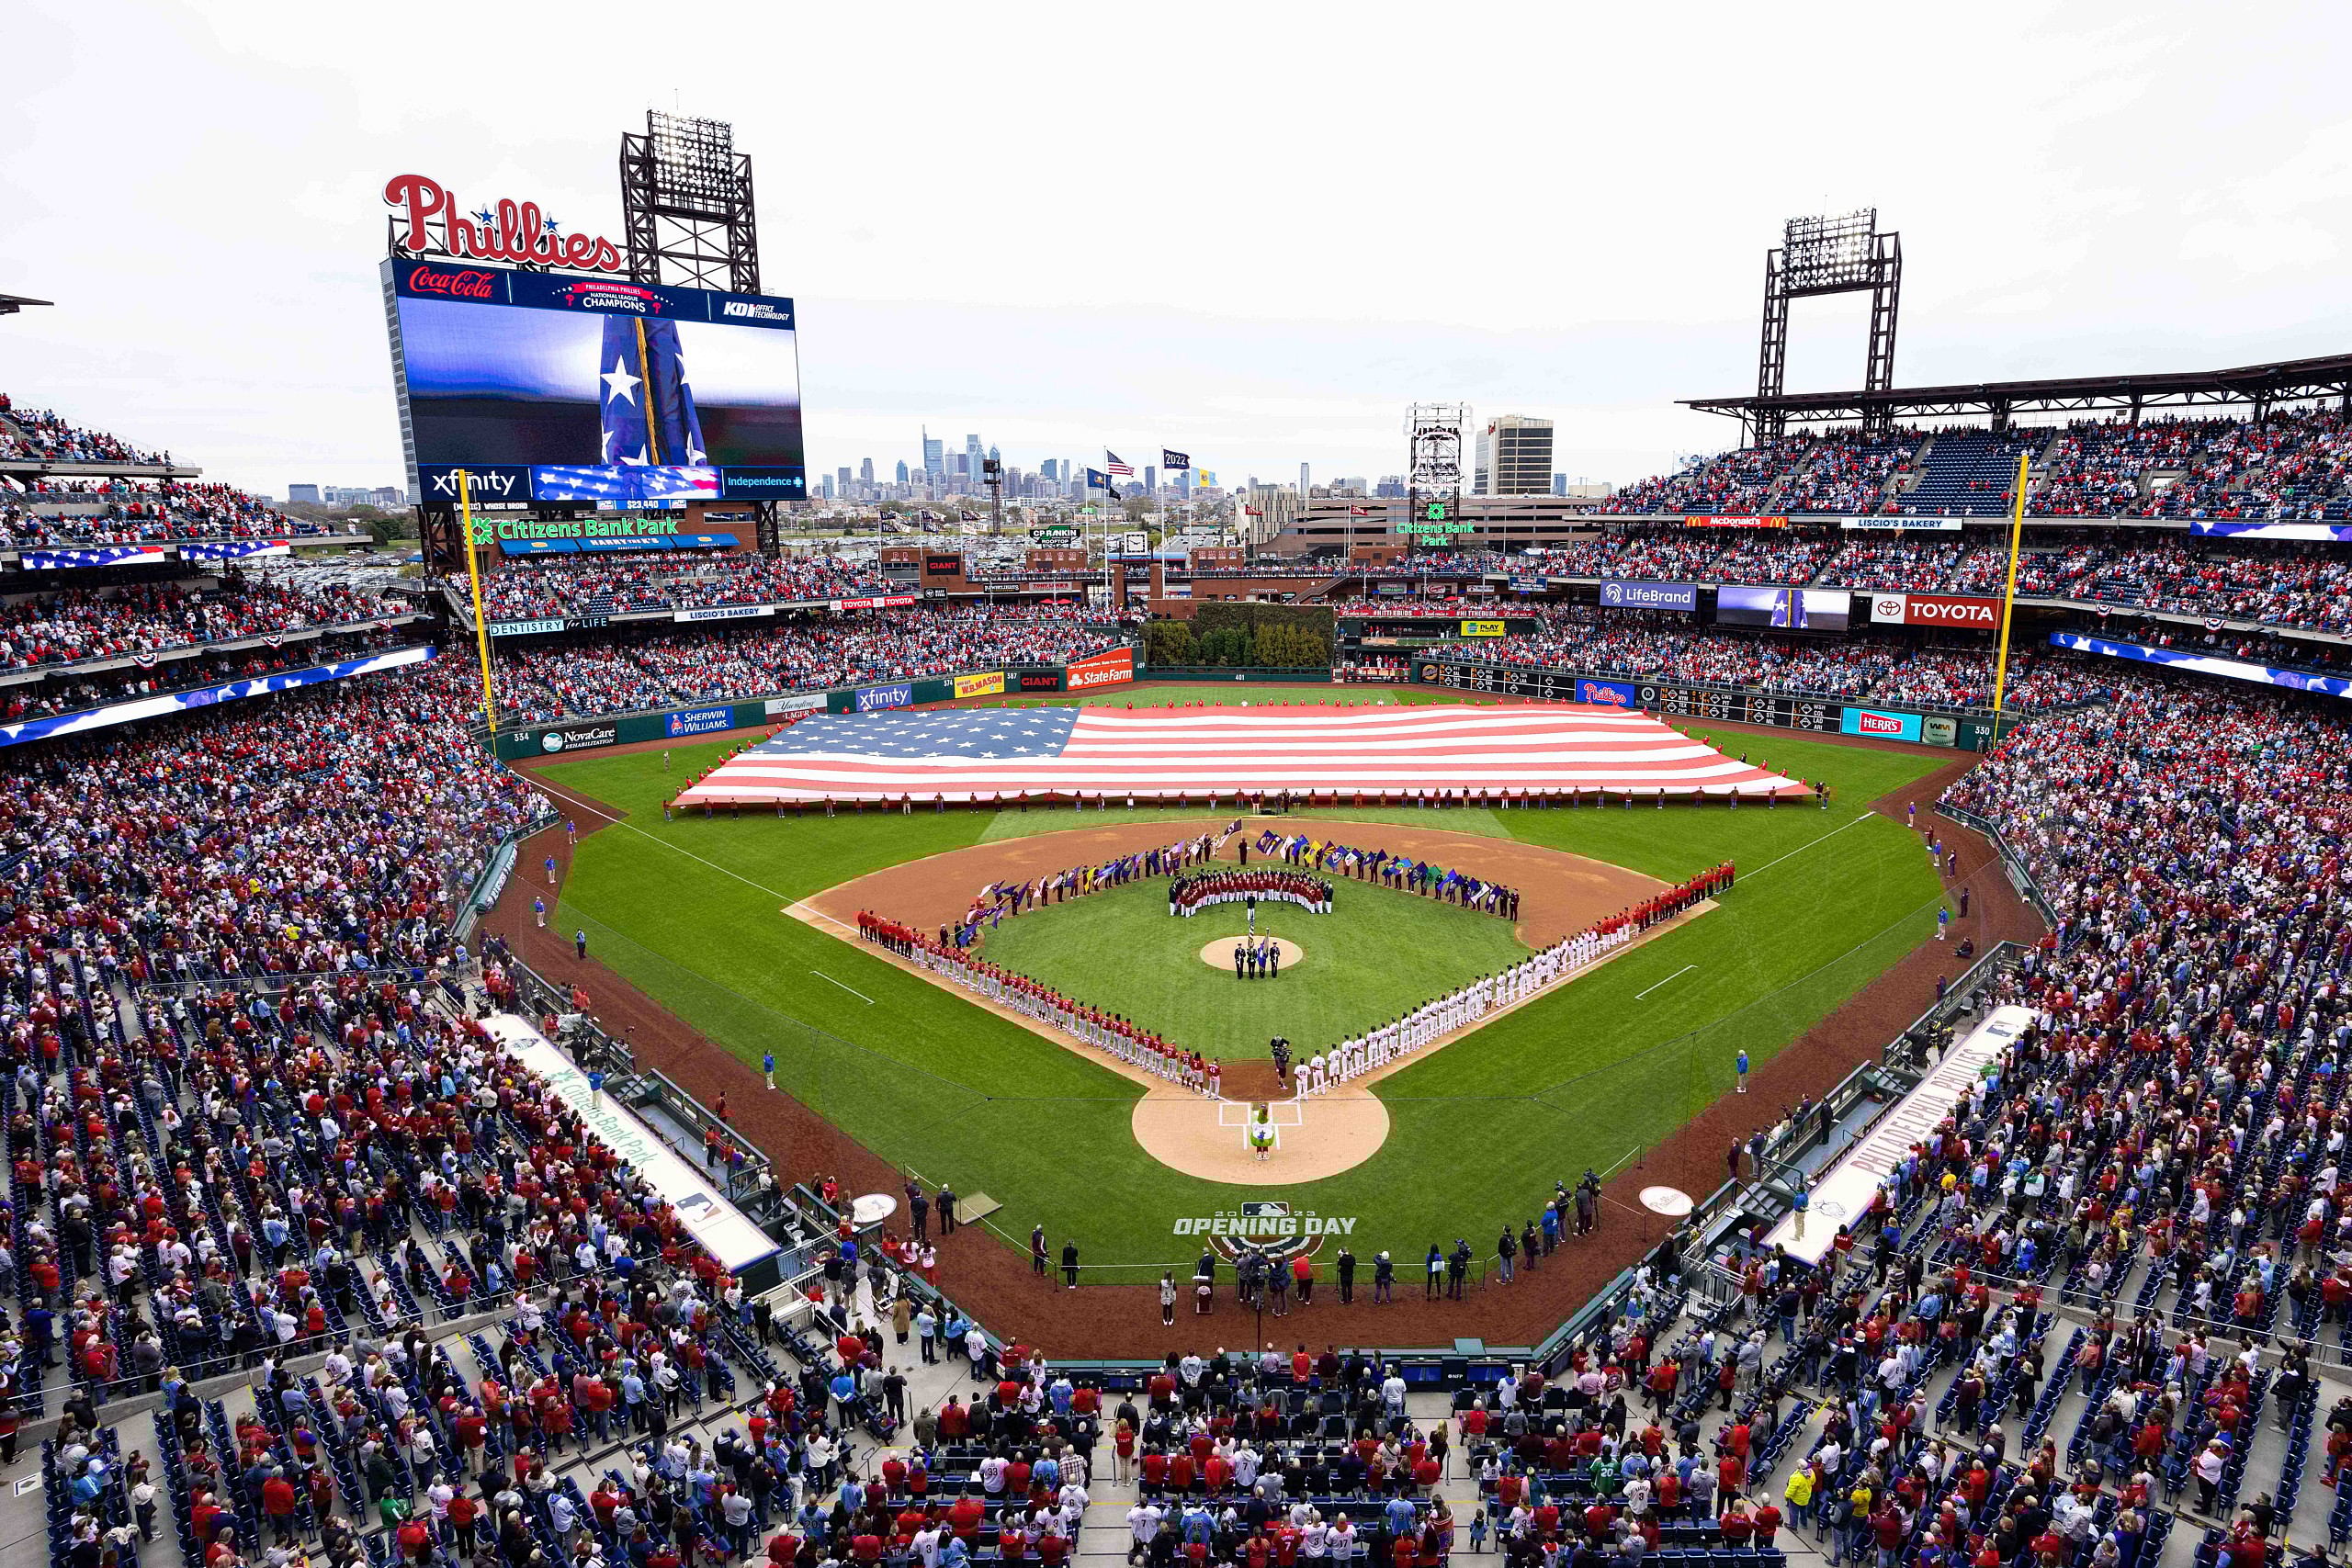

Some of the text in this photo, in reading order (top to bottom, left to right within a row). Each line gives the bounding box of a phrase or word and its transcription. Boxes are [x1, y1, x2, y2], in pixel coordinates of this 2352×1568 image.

[383, 174, 622, 272] Phillies
[409, 266, 495, 298] Coca-Cola
[585, 284, 641, 295] PHILADELPHIA PHILLIES
[582, 297, 646, 313] CHAMPIONS
[754, 310, 790, 321] TECHNOLOGY
[1165, 453, 1186, 465] 2022
[432, 469, 515, 496] xfnity
[728, 476, 792, 488] Independence
[507, 502, 527, 510] BROAD
[627, 500, 659, 509] $23,440
[1710, 517, 1761, 525] McDonald's
[1858, 519, 1942, 528] LISCIO'S BAKERY
[498, 517, 678, 539] Citizens Bank Park
[1396, 522, 1475, 534] Citizens Bank
[590, 538, 628, 547] HARRY
[1422, 535, 1449, 547] Park
[1626, 589, 1691, 604] LifeBrand
[843, 597, 913, 609] TOYOTA TOYOTA
[689, 607, 759, 619] LISCIO'S BAKERY
[1910, 603, 1994, 622] TOYOTA
[491, 617, 607, 635] DENTISTRY for LIFE
[1021, 677, 1058, 686] GIANT
[860, 687, 909, 708] xfinity
[1584, 683, 1626, 704] Phillies
[777, 698, 816, 711] Yuengling
[684, 710, 726, 722] SHERWIN
[1862, 716, 1898, 731] HERR'S
[1929, 722, 1951, 731] WM
[514, 732, 529, 742] 334
[563, 728, 615, 743] NovaCare
[1975, 726, 1990, 736] 330
[565, 739, 614, 750] REHABILITATION
[1930, 1048, 1995, 1092] PHILLIES
[561, 1084, 658, 1166] Citizens Bank Park
[1849, 1094, 1954, 1177] PHILADELPHIA
[1649, 1192, 1681, 1211] Phillies
[1172, 1217, 1358, 1235] OPENING DAY
[988, 1468, 998, 1476] 33
[1600, 1468, 1613, 1477] 20
[805, 1520, 819, 1529] 20
